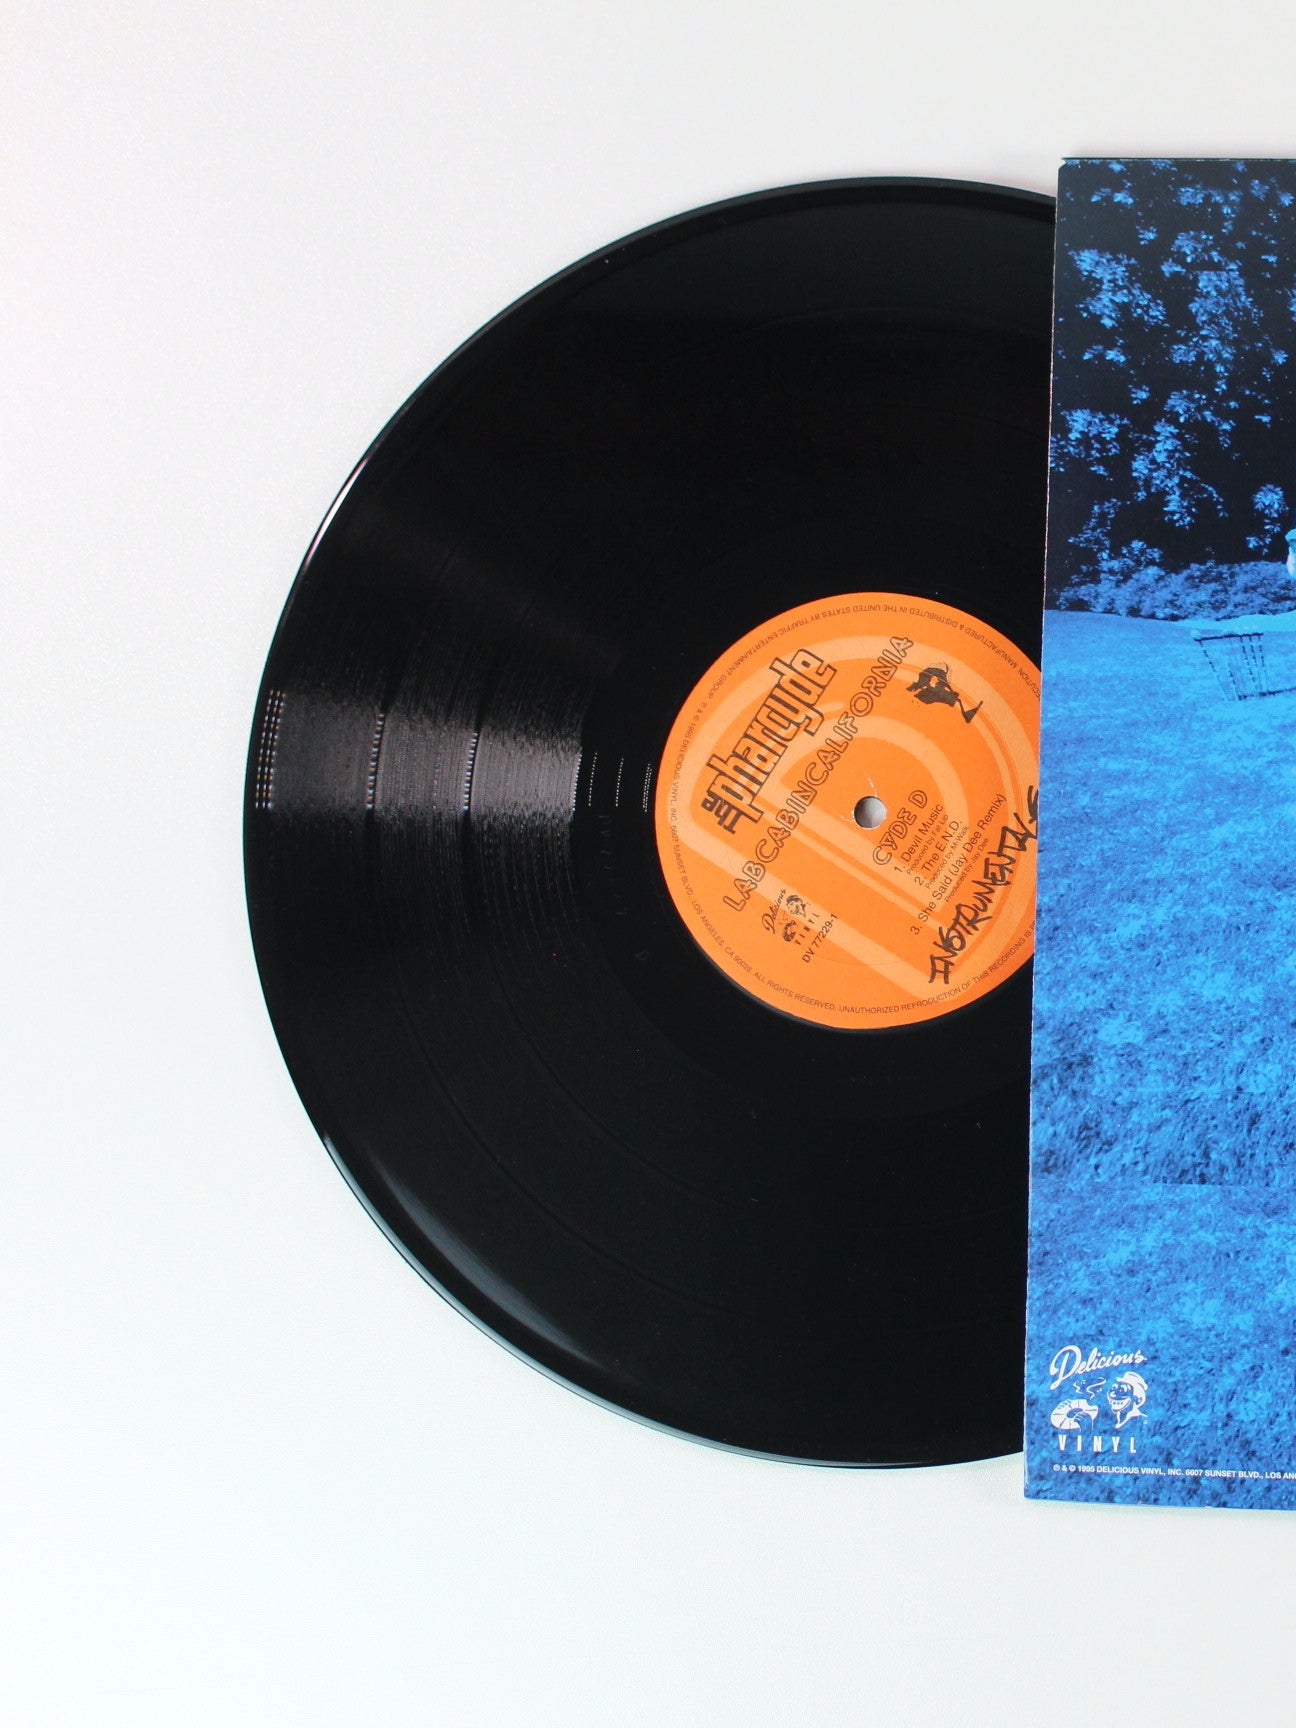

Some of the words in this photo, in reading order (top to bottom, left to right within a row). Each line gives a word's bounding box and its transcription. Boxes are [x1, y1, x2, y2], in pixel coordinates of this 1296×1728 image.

[779, 618, 808, 636] TRAFFIC
[822, 608, 851, 619] STATES
[853, 604, 882, 613] UNITED
[909, 608, 958, 628] DISTRIBUTED
[727, 632, 778, 675] ENTERTAINMENT
[965, 627, 1017, 669] MANUFACTURED
[708, 676, 727, 699] GROUP
[672, 740, 689, 781] DELICIOUS
[723, 636, 914, 912] LABCABINCALIFORNIA
[872, 807, 917, 865] CYDE
[908, 790, 928, 809] D
[893, 864, 906, 873] 1.
[901, 835, 922, 862] Devil
[918, 804, 943, 835] Music
[672, 844, 687, 874] SUNSET
[906, 844, 928, 875] Produced
[931, 822, 943, 836] Fat
[910, 926, 922, 934] 3.
[918, 902, 936, 922] She
[932, 875, 952, 900] Said
[948, 854, 968, 876] (Jay
[962, 832, 981, 852] Dee
[977, 794, 1007, 830] Remix)
[914, 876, 926, 886] 2.
[921, 853, 939, 871] The
[935, 821, 962, 852] E.N.D.
[925, 859, 948, 889] Produced
[950, 826, 970, 850] M-Walk
[944, 871, 967, 902] Produced
[971, 852, 981, 863] Jay
[977, 838, 989, 851] Dee
[761, 889, 786, 934] Delicious
[700, 915, 725, 947] ANGELES,
[802, 948, 814, 963] DV
[811, 914, 838, 947] 77229-1
[989, 938, 1026, 972] RECORDING
[767, 980, 794, 998] RIGHTS
[794, 993, 837, 1011] RESERVED.
[901, 987, 961, 1011] REPRODUCTION
[839, 1005, 899, 1014] UNAUTHORIZED
[1050, 1345, 1147, 1390] Delicious
[1058, 1435, 1136, 1453] VINYL
[1078, 1465, 1095, 1474] 1995
[1097, 1465, 1139, 1475] DELICIOUS
[1141, 1467, 1166, 1477] VINYL,
[1168, 1468, 1184, 1477] INC.
[1204, 1469, 1236, 1479] SUNSET
[1238, 1470, 1264, 1481] BLVD.,
[1265, 1471, 1282, 1480] LOS
